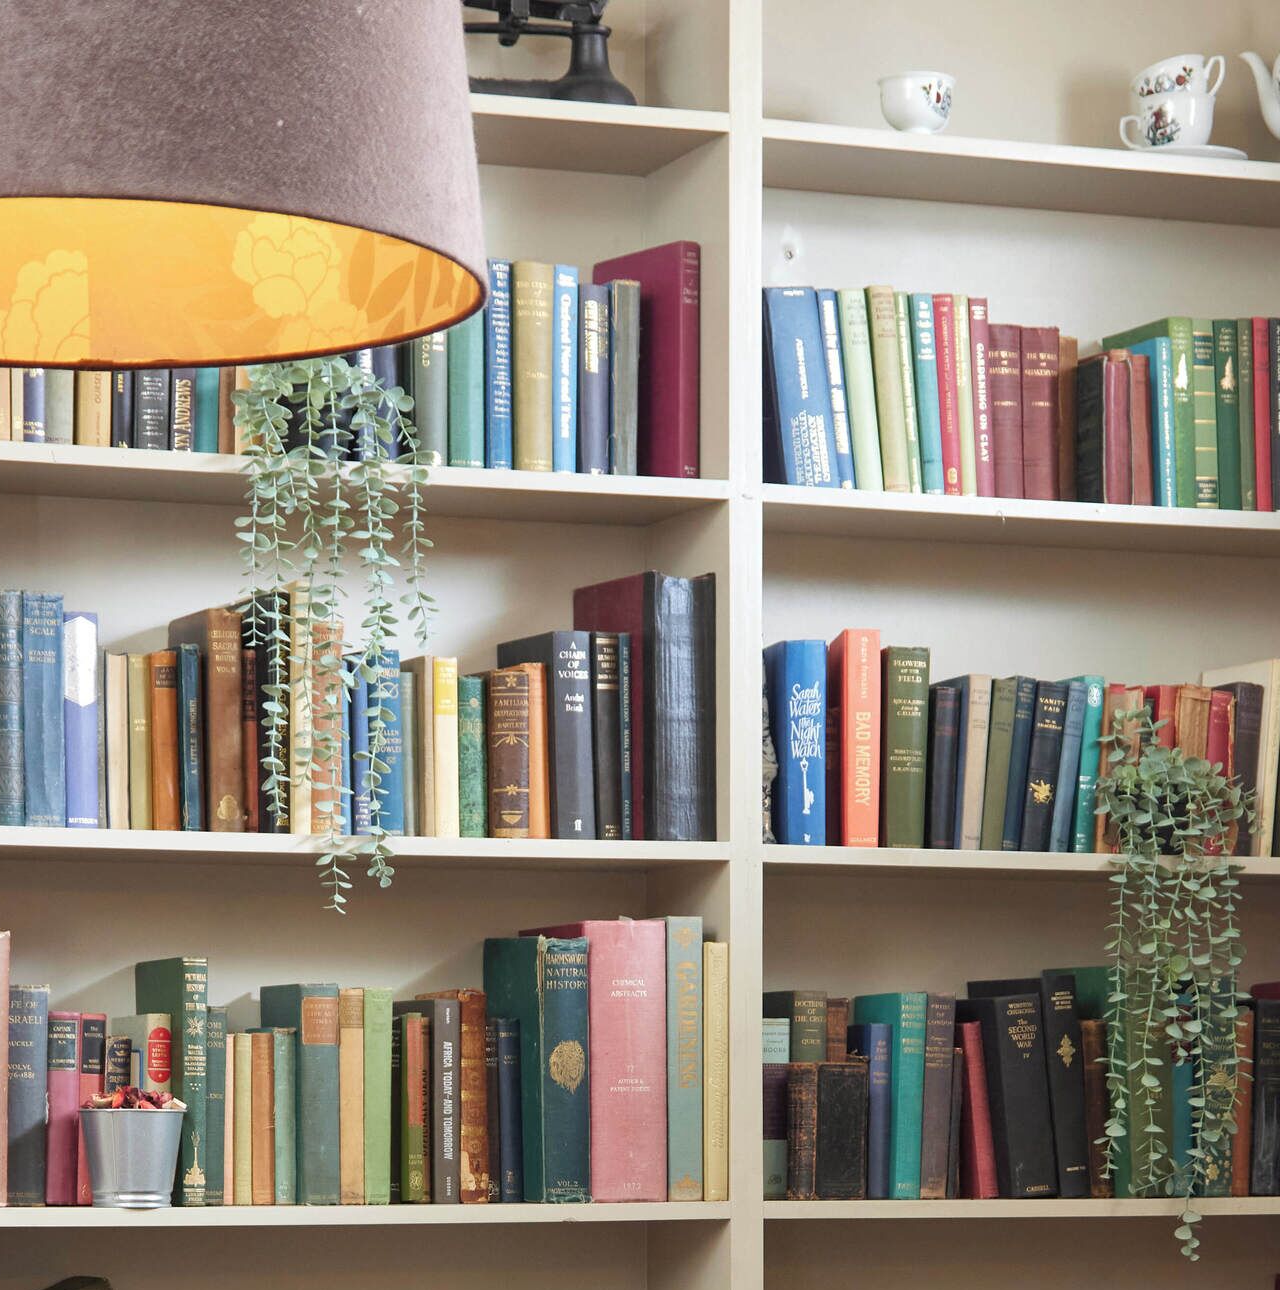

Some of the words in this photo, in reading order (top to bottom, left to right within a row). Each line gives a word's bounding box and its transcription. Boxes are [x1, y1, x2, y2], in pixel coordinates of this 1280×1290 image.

[976, 343, 987, 410] GARDENING
[980, 434, 989, 462] CLAY
[559, 650, 586, 659] CHAIN
[567, 661, 580, 669] OF
[893, 660, 927, 668] FLOWERS
[558, 670, 588, 679] VOICES
[791, 681, 821, 701] Sarah
[790, 700, 821, 717] Waters
[1039, 698, 1065, 706] VANITY
[791, 720, 822, 745] Night
[855, 712, 871, 740] BAD
[792, 740, 822, 759] Watch
[855, 745, 871, 806] MEMORY
[546, 967, 587, 977] NATURAL
[546, 979, 587, 990] HISTORY
[1008, 1025, 1038, 1033] SECOND
[443, 1041, 453, 1067] AFRICA
[443, 1120, 453, 1160] TOMORROW
